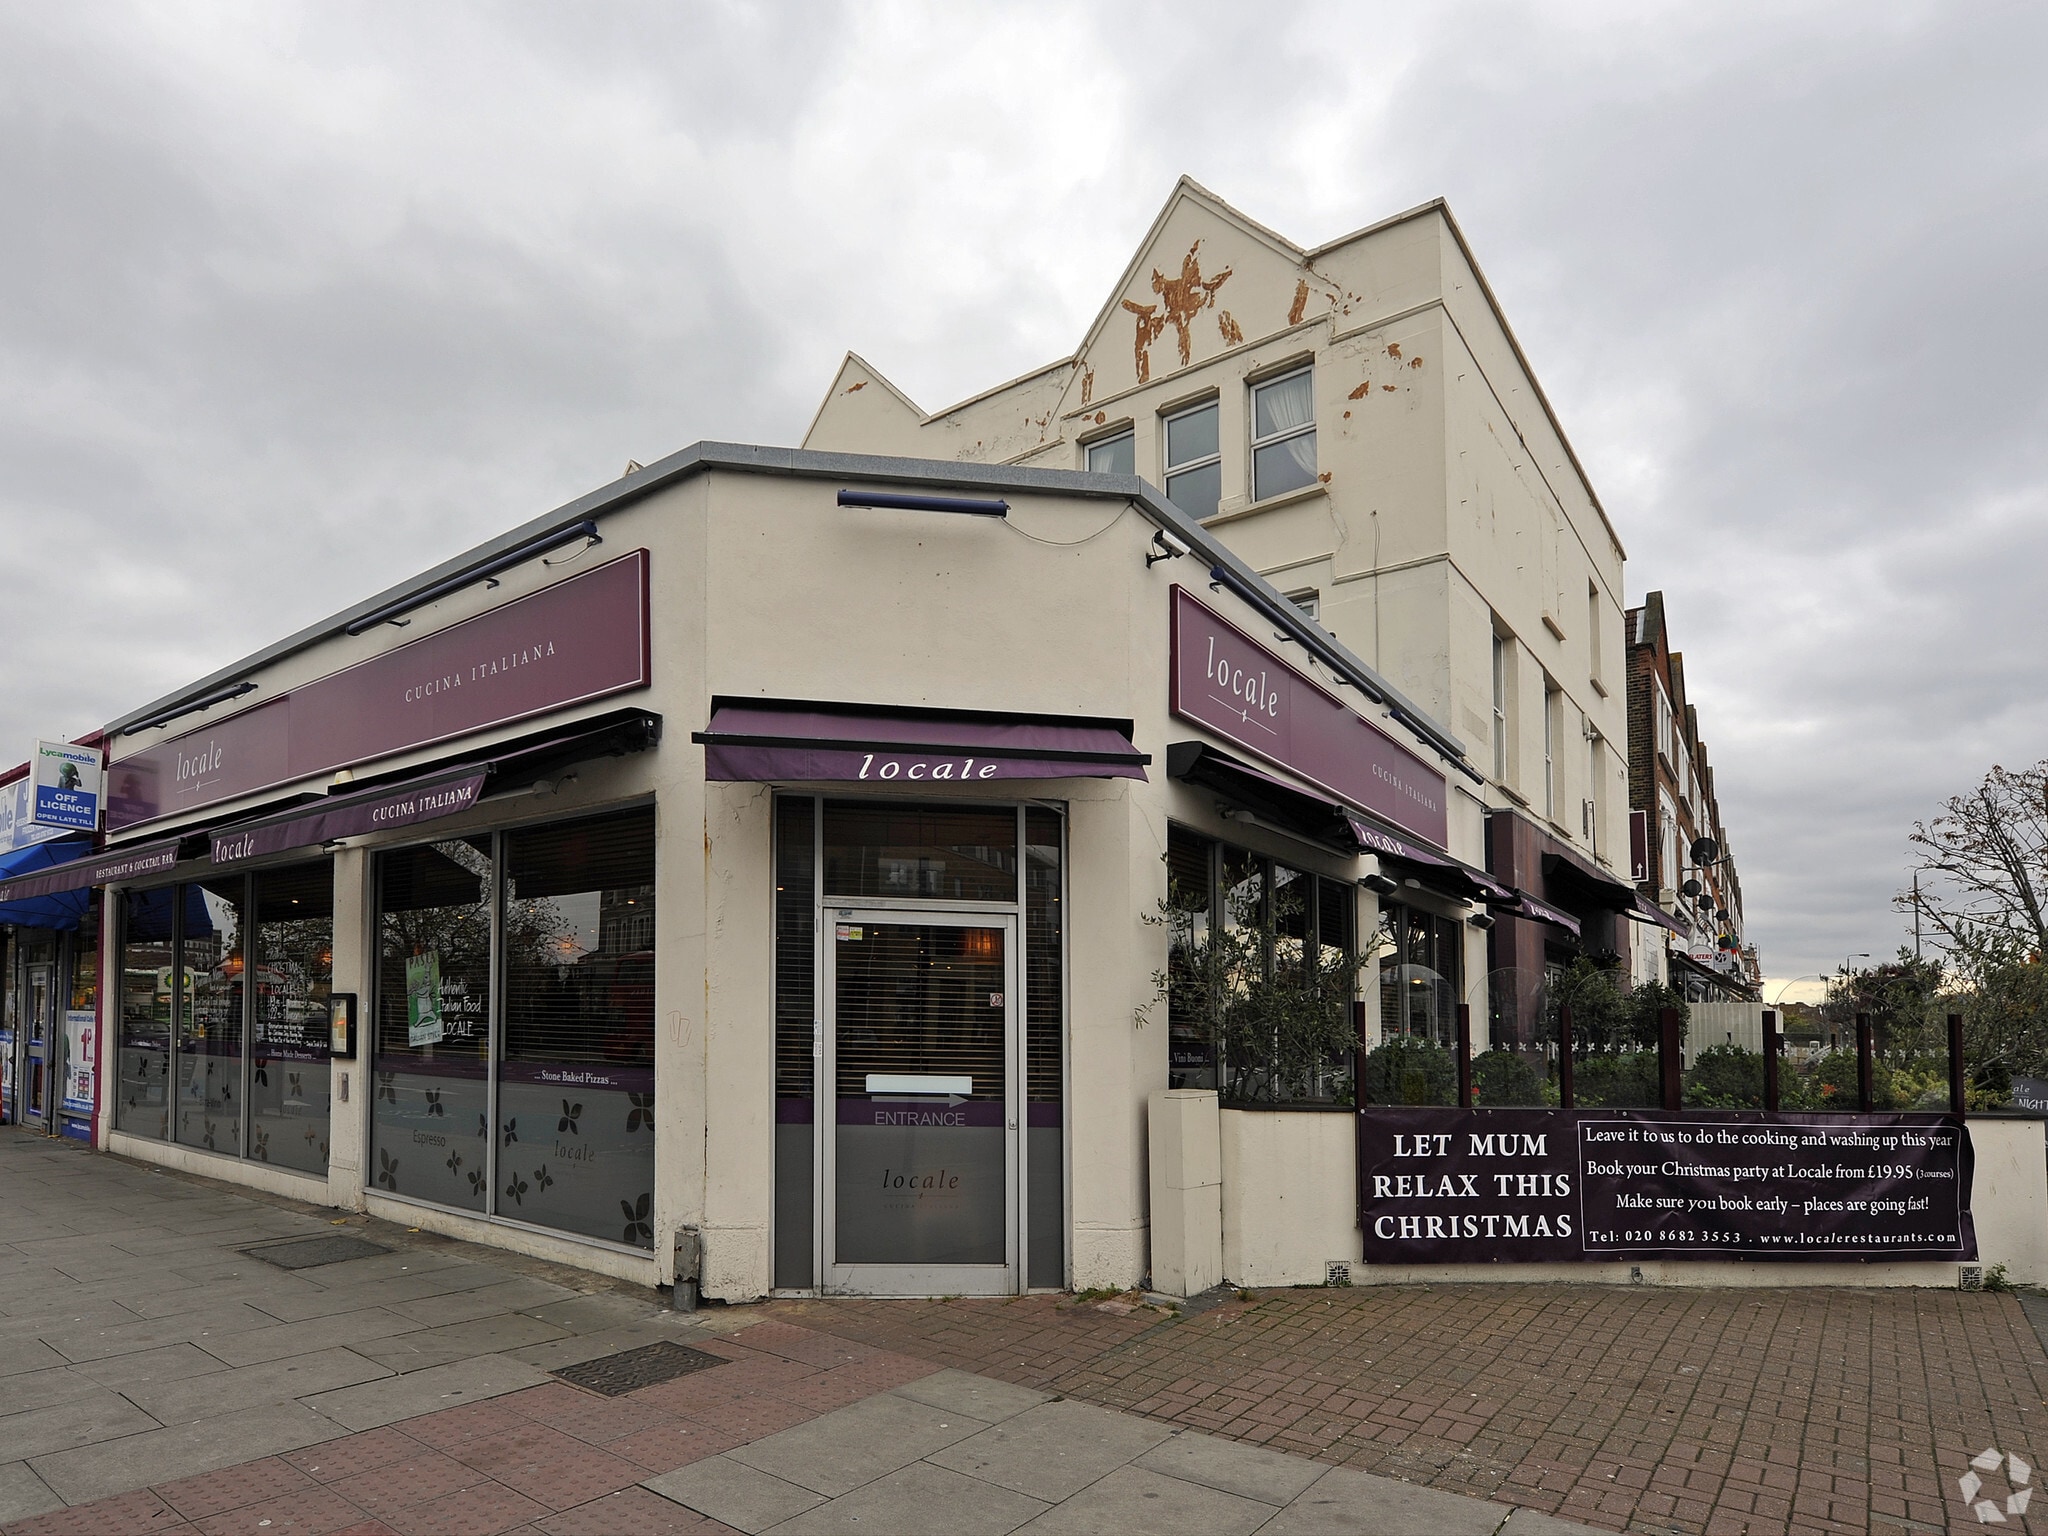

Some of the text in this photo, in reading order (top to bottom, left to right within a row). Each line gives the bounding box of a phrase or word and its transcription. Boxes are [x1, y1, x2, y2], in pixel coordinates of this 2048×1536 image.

[404, 641, 556, 703] CUCINA ITALIANA
[1207, 636, 1278, 717] locale
[40, 747, 96, 764] Lycamobile
[176, 740, 222, 782] locale
[859, 754, 997, 779] locale
[55, 793, 78, 803] OFF
[1372, 763, 1437, 812] CUCINA ITALIANA
[40, 800, 92, 815] LICENCE
[372, 786, 472, 822] CUCINA ITALIANA
[36, 812, 93, 826] OPEN LATE TILL
[215, 833, 255, 863] locale
[1355, 821, 1406, 856] locale
[95, 853, 175, 879] RESTAURANT & COCKTAIL BAR
[463, 993, 481, 1013] Food
[442, 1020, 475, 1036] LOCALE
[271, 1049, 282, 1057] Home
[541, 1069, 561, 1081] Stone
[562, 1070, 584, 1083] Baked
[585, 1072, 610, 1085] Pizzas
[875, 1111, 965, 1127] ENTRANCE
[413, 1129, 446, 1147] Espresso
[1393, 1133, 1548, 1157] LET MUM
[1586, 1127, 1953, 1150] Leave it to us to do the cooking and washing up this year
[554, 1139, 595, 1162] locale
[883, 1169, 959, 1189] locale
[1587, 1160, 1624, 1175] Book
[1626, 1163, 1658, 1179] your
[1661, 1161, 1731, 1177] Christmas
[1733, 1165, 1769, 1181] party
[1771, 1166, 1785, 1178] at
[1787, 1164, 1833, 1178] Locale
[1835, 1164, 1865, 1178] from
[1867, 1165, 1913, 1179] £19.95
[1372, 1174, 1571, 1198] RELAX THIS
[1616, 1193, 1653, 1208] Make
[1656, 1197, 1684, 1209] sure
[1688, 1199, 1716, 1212] you
[1719, 1195, 1753, 1210] book
[1756, 1195, 1788, 1215] early
[1804, 1196, 1844, 1215] places
[1846, 1200, 1867, 1211] are
[1870, 1198, 1906, 1215] going
[1907, 1196, 1929, 1210] fast!
[1374, 1214, 1573, 1239] CHRISTMAS
[1589, 1231, 1620, 1242] Tel:
[1625, 1230, 1652, 1241] 020
[1659, 1230, 1695, 1241] 8682
[1701, 1231, 1741, 1243] 3553
[1760, 1232, 1956, 1244] www.localerestaurants.com
